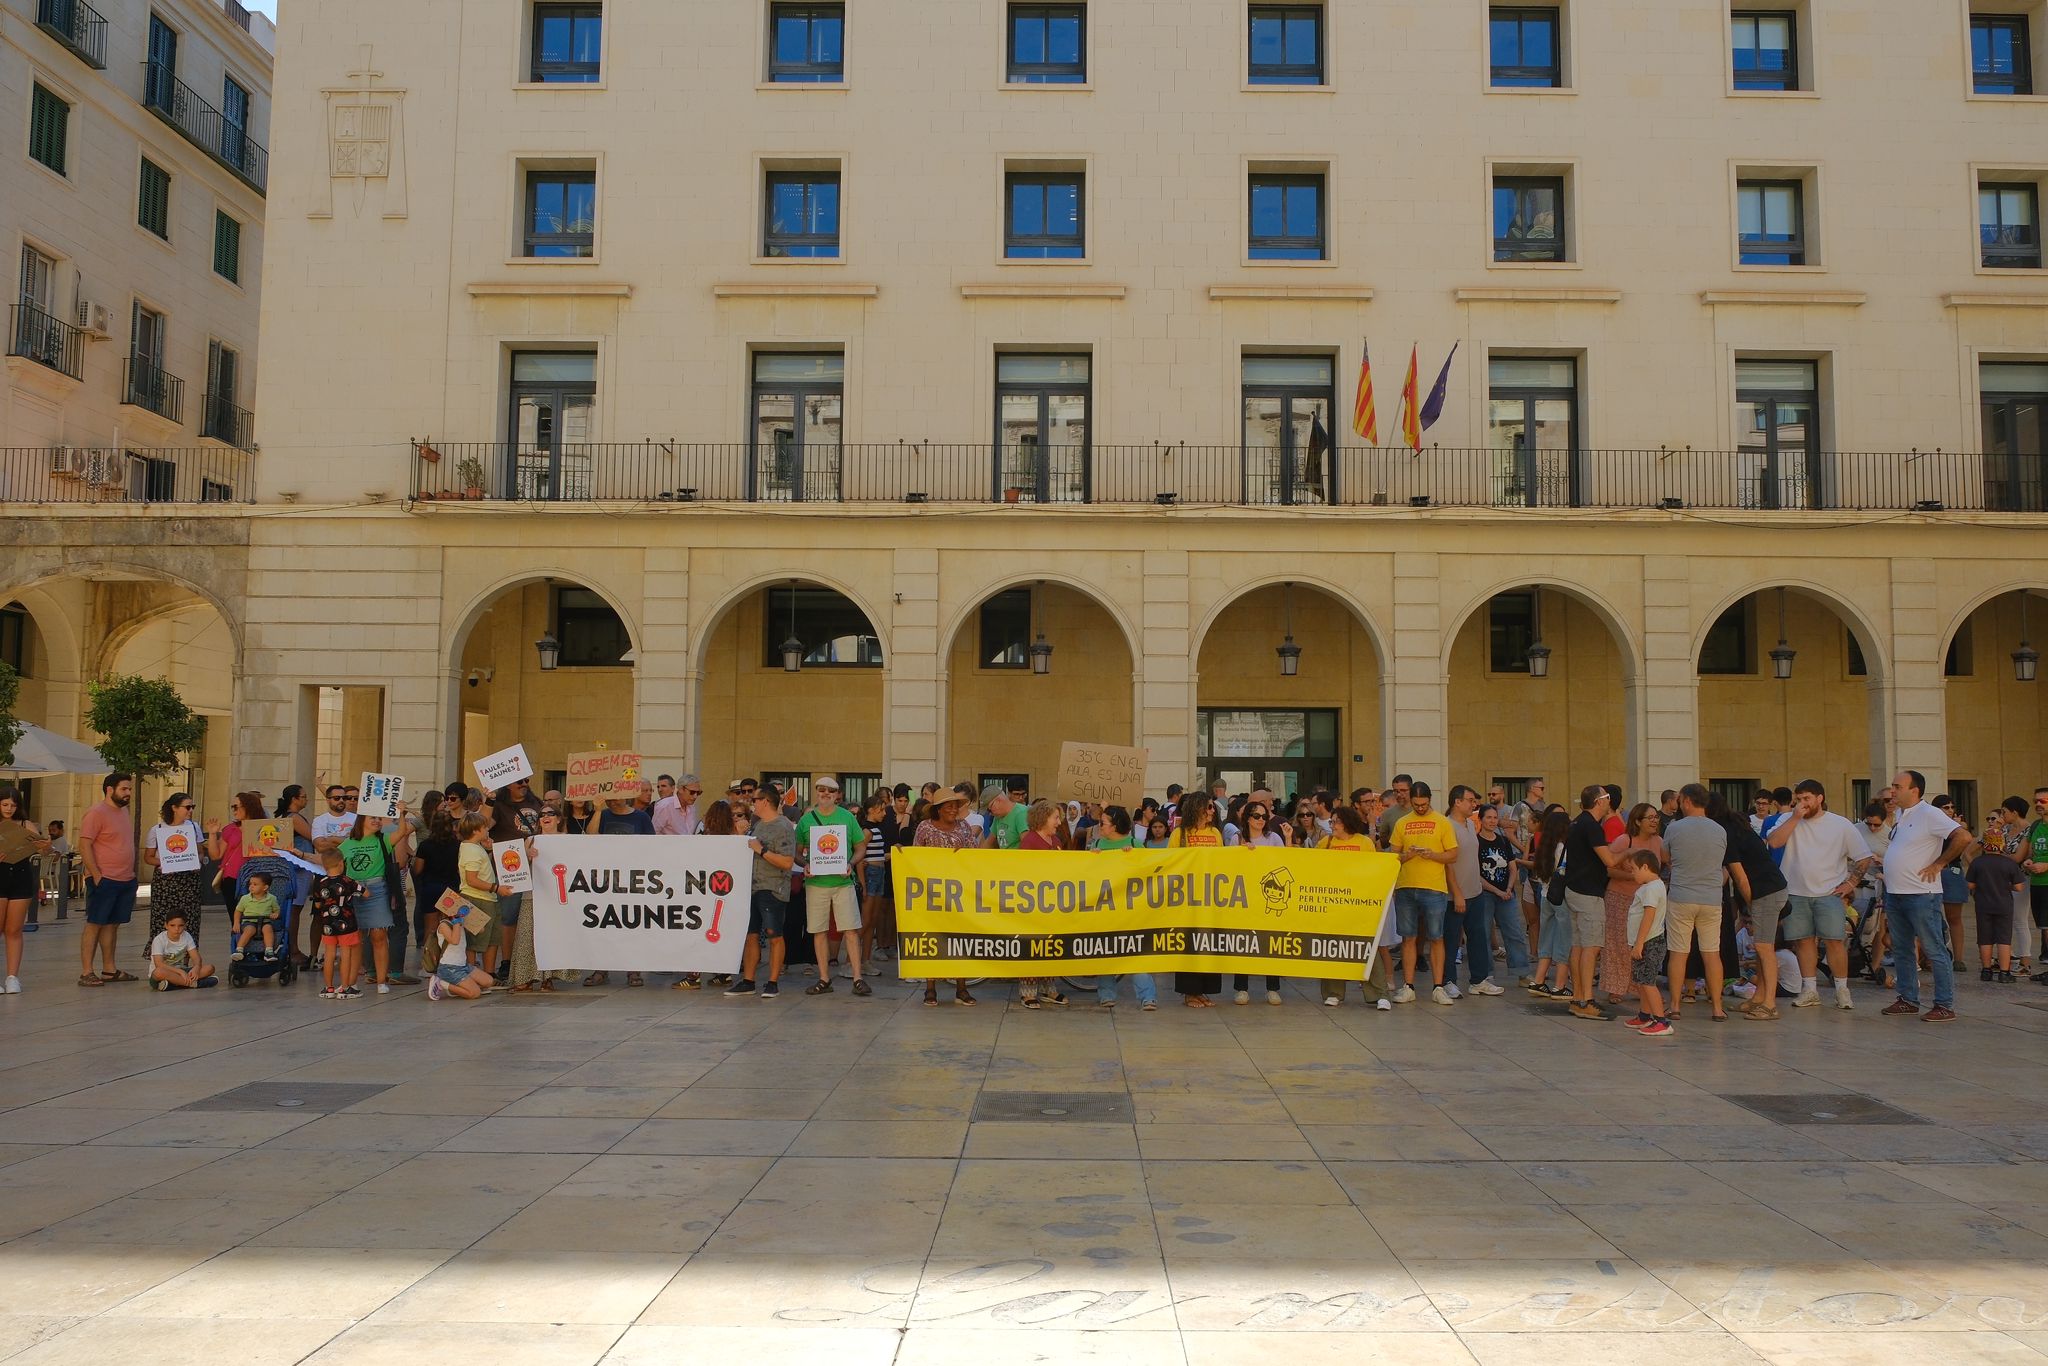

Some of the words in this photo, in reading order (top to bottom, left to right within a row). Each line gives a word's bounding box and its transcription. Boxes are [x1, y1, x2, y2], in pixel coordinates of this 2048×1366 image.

[1097, 769, 1112, 781] ES
[1119, 772, 1141, 784] UNA
[363, 774, 374, 803] SAUNAS
[373, 779, 384, 796] NO
[382, 777, 391, 801] AULAS
[598, 781, 613, 793] NO
[1073, 780, 1122, 800] SAUNA
[905, 876, 964, 913] PER
[975, 879, 1116, 914] L'ESCOLA
[1125, 866, 1249, 910] PÚBLICA
[1299, 885, 1352, 896] PLATAFORMA
[1298, 895, 1314, 903] PER
[1317, 896, 1383, 907] L'ENSENYAMENT
[1298, 903, 1328, 913] PÚBLIC
[904, 933, 938, 957] MÉS
[947, 935, 1021, 957] INVERSIÓ
[1030, 935, 1064, 957] MÉS
[1072, 934, 1145, 956] QUALITAT
[1153, 928, 1186, 952] MÉS
[1192, 930, 1260, 954] VALENCIÀ
[1268, 932, 1302, 956] MÉS
